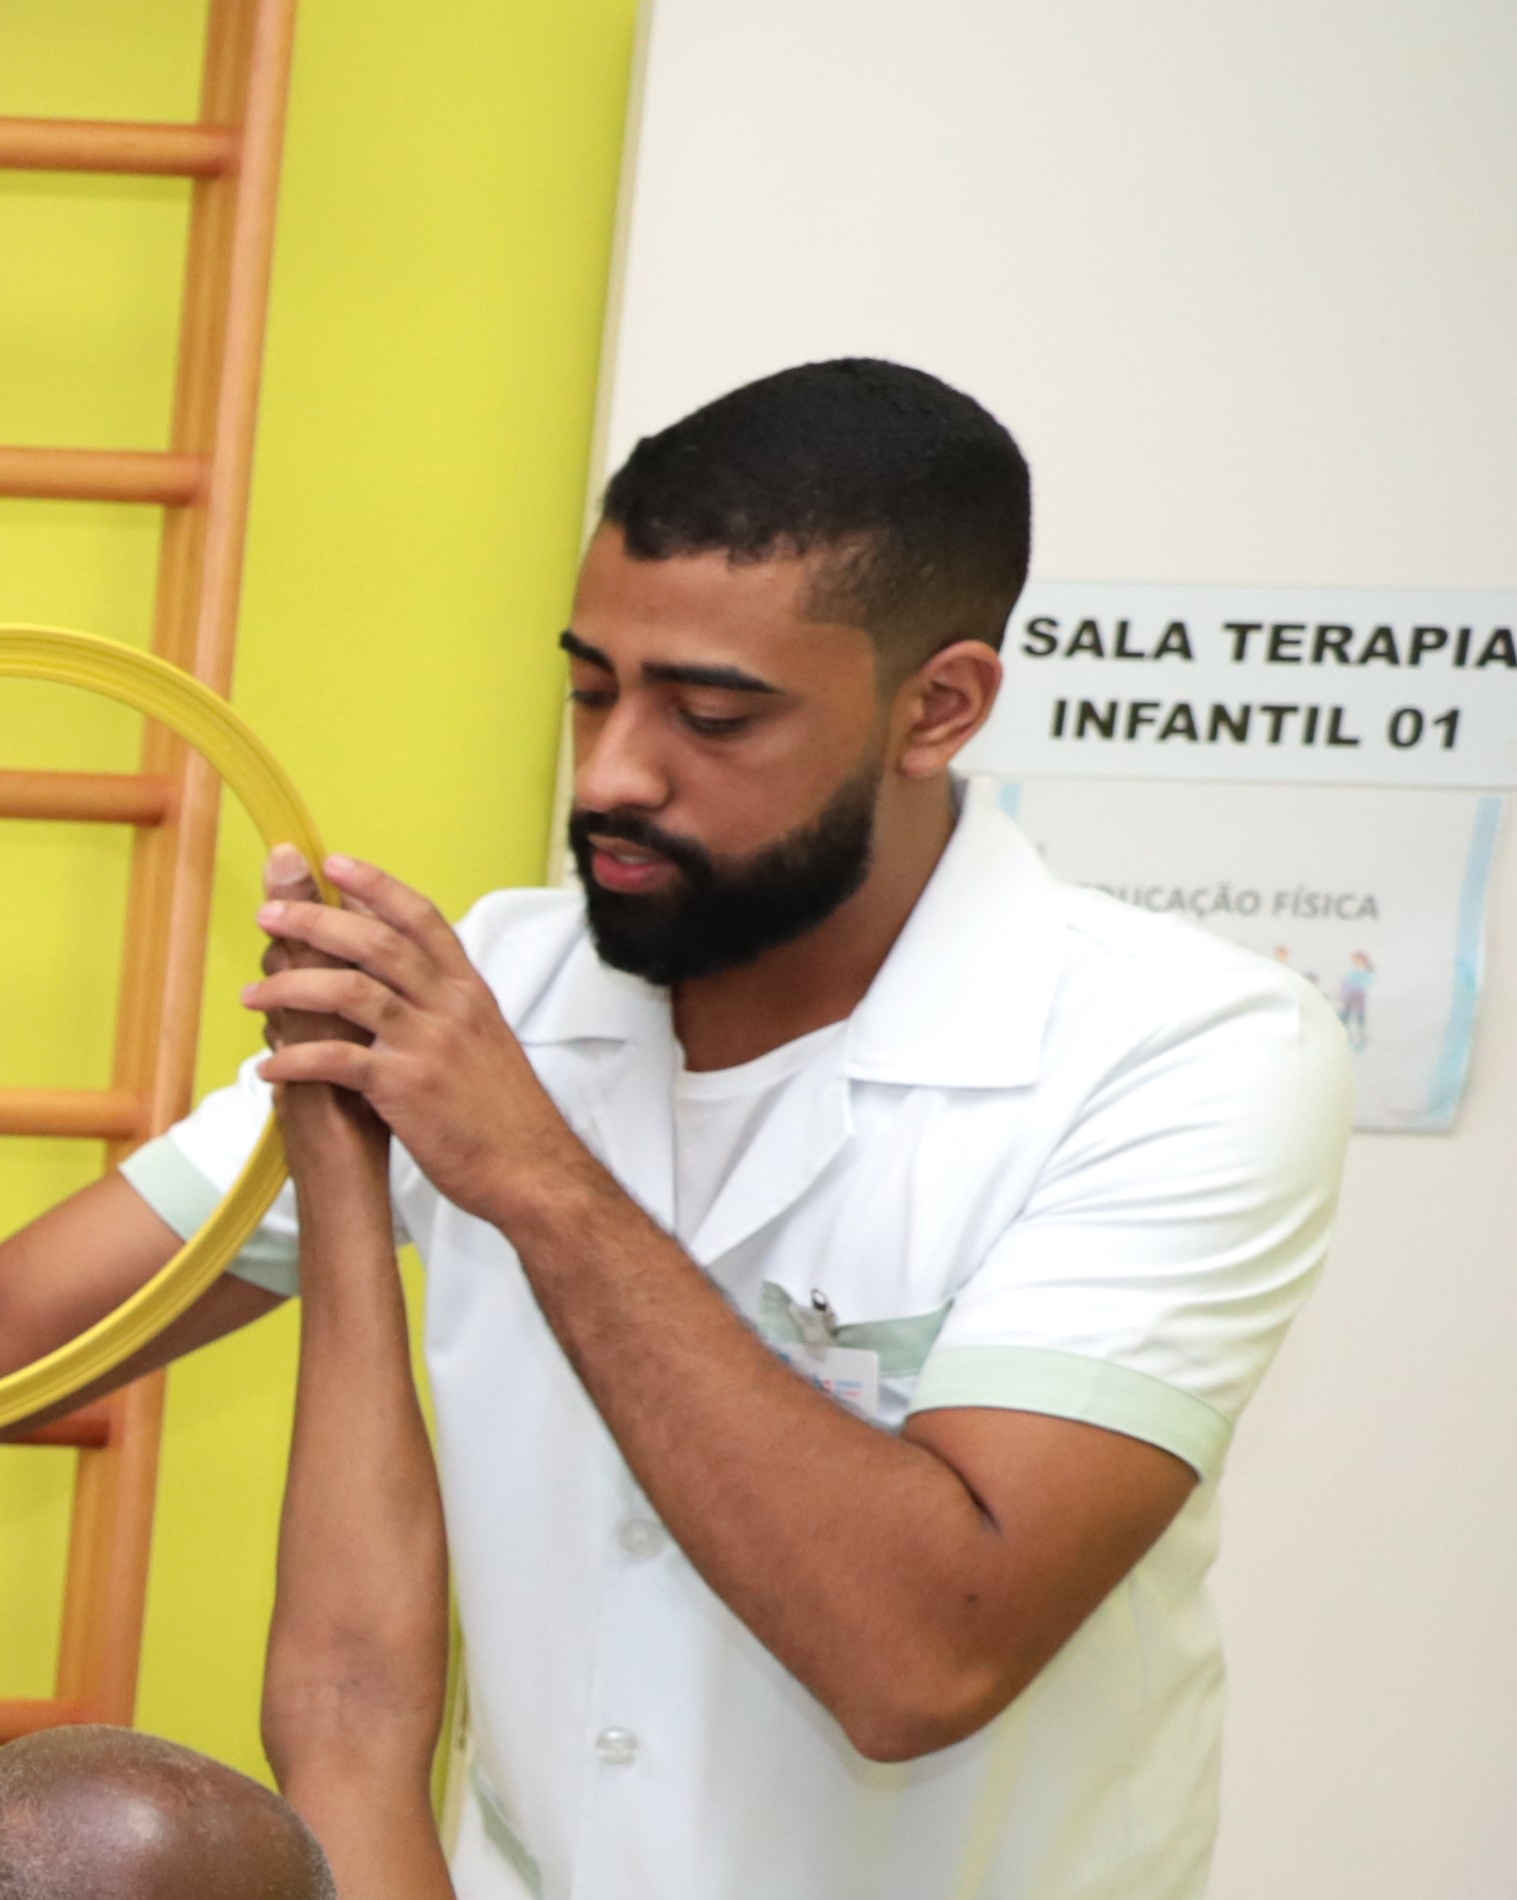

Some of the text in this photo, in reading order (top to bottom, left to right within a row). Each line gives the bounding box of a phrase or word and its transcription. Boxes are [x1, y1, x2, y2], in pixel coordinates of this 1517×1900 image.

[1020, 616, 1517, 669] SALA TERAPIA
[1049, 698, 1462, 751] INFANTIL 01
[1272, 884, 1379, 921] FÍSICA
